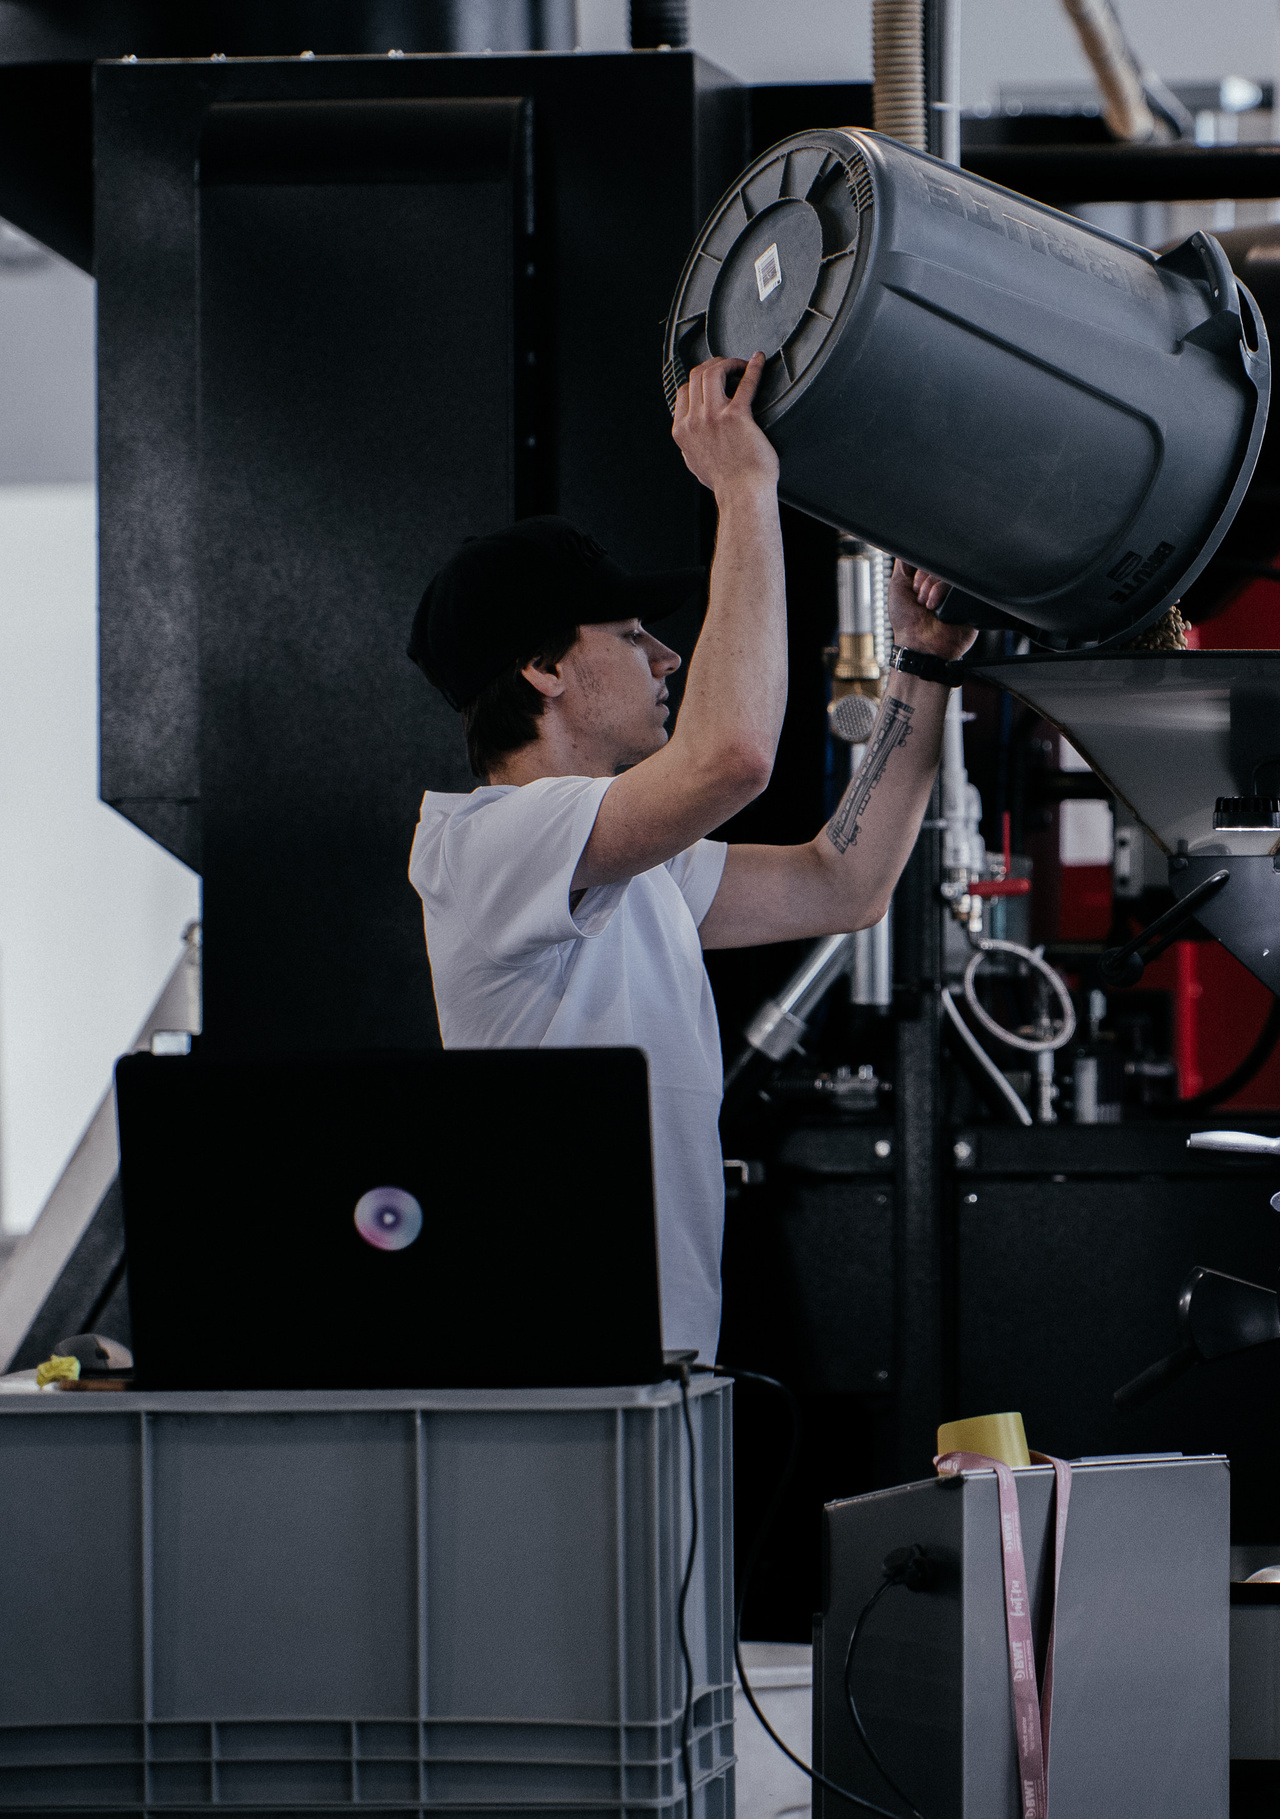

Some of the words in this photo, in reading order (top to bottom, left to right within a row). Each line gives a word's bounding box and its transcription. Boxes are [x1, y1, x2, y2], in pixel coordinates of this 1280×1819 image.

[920, 172, 1131, 293] BRUTE
[1107, 540, 1177, 605] BRUTE
[1012, 1641, 1025, 1670] BWT
[1023, 1779, 1036, 1807] BWT
